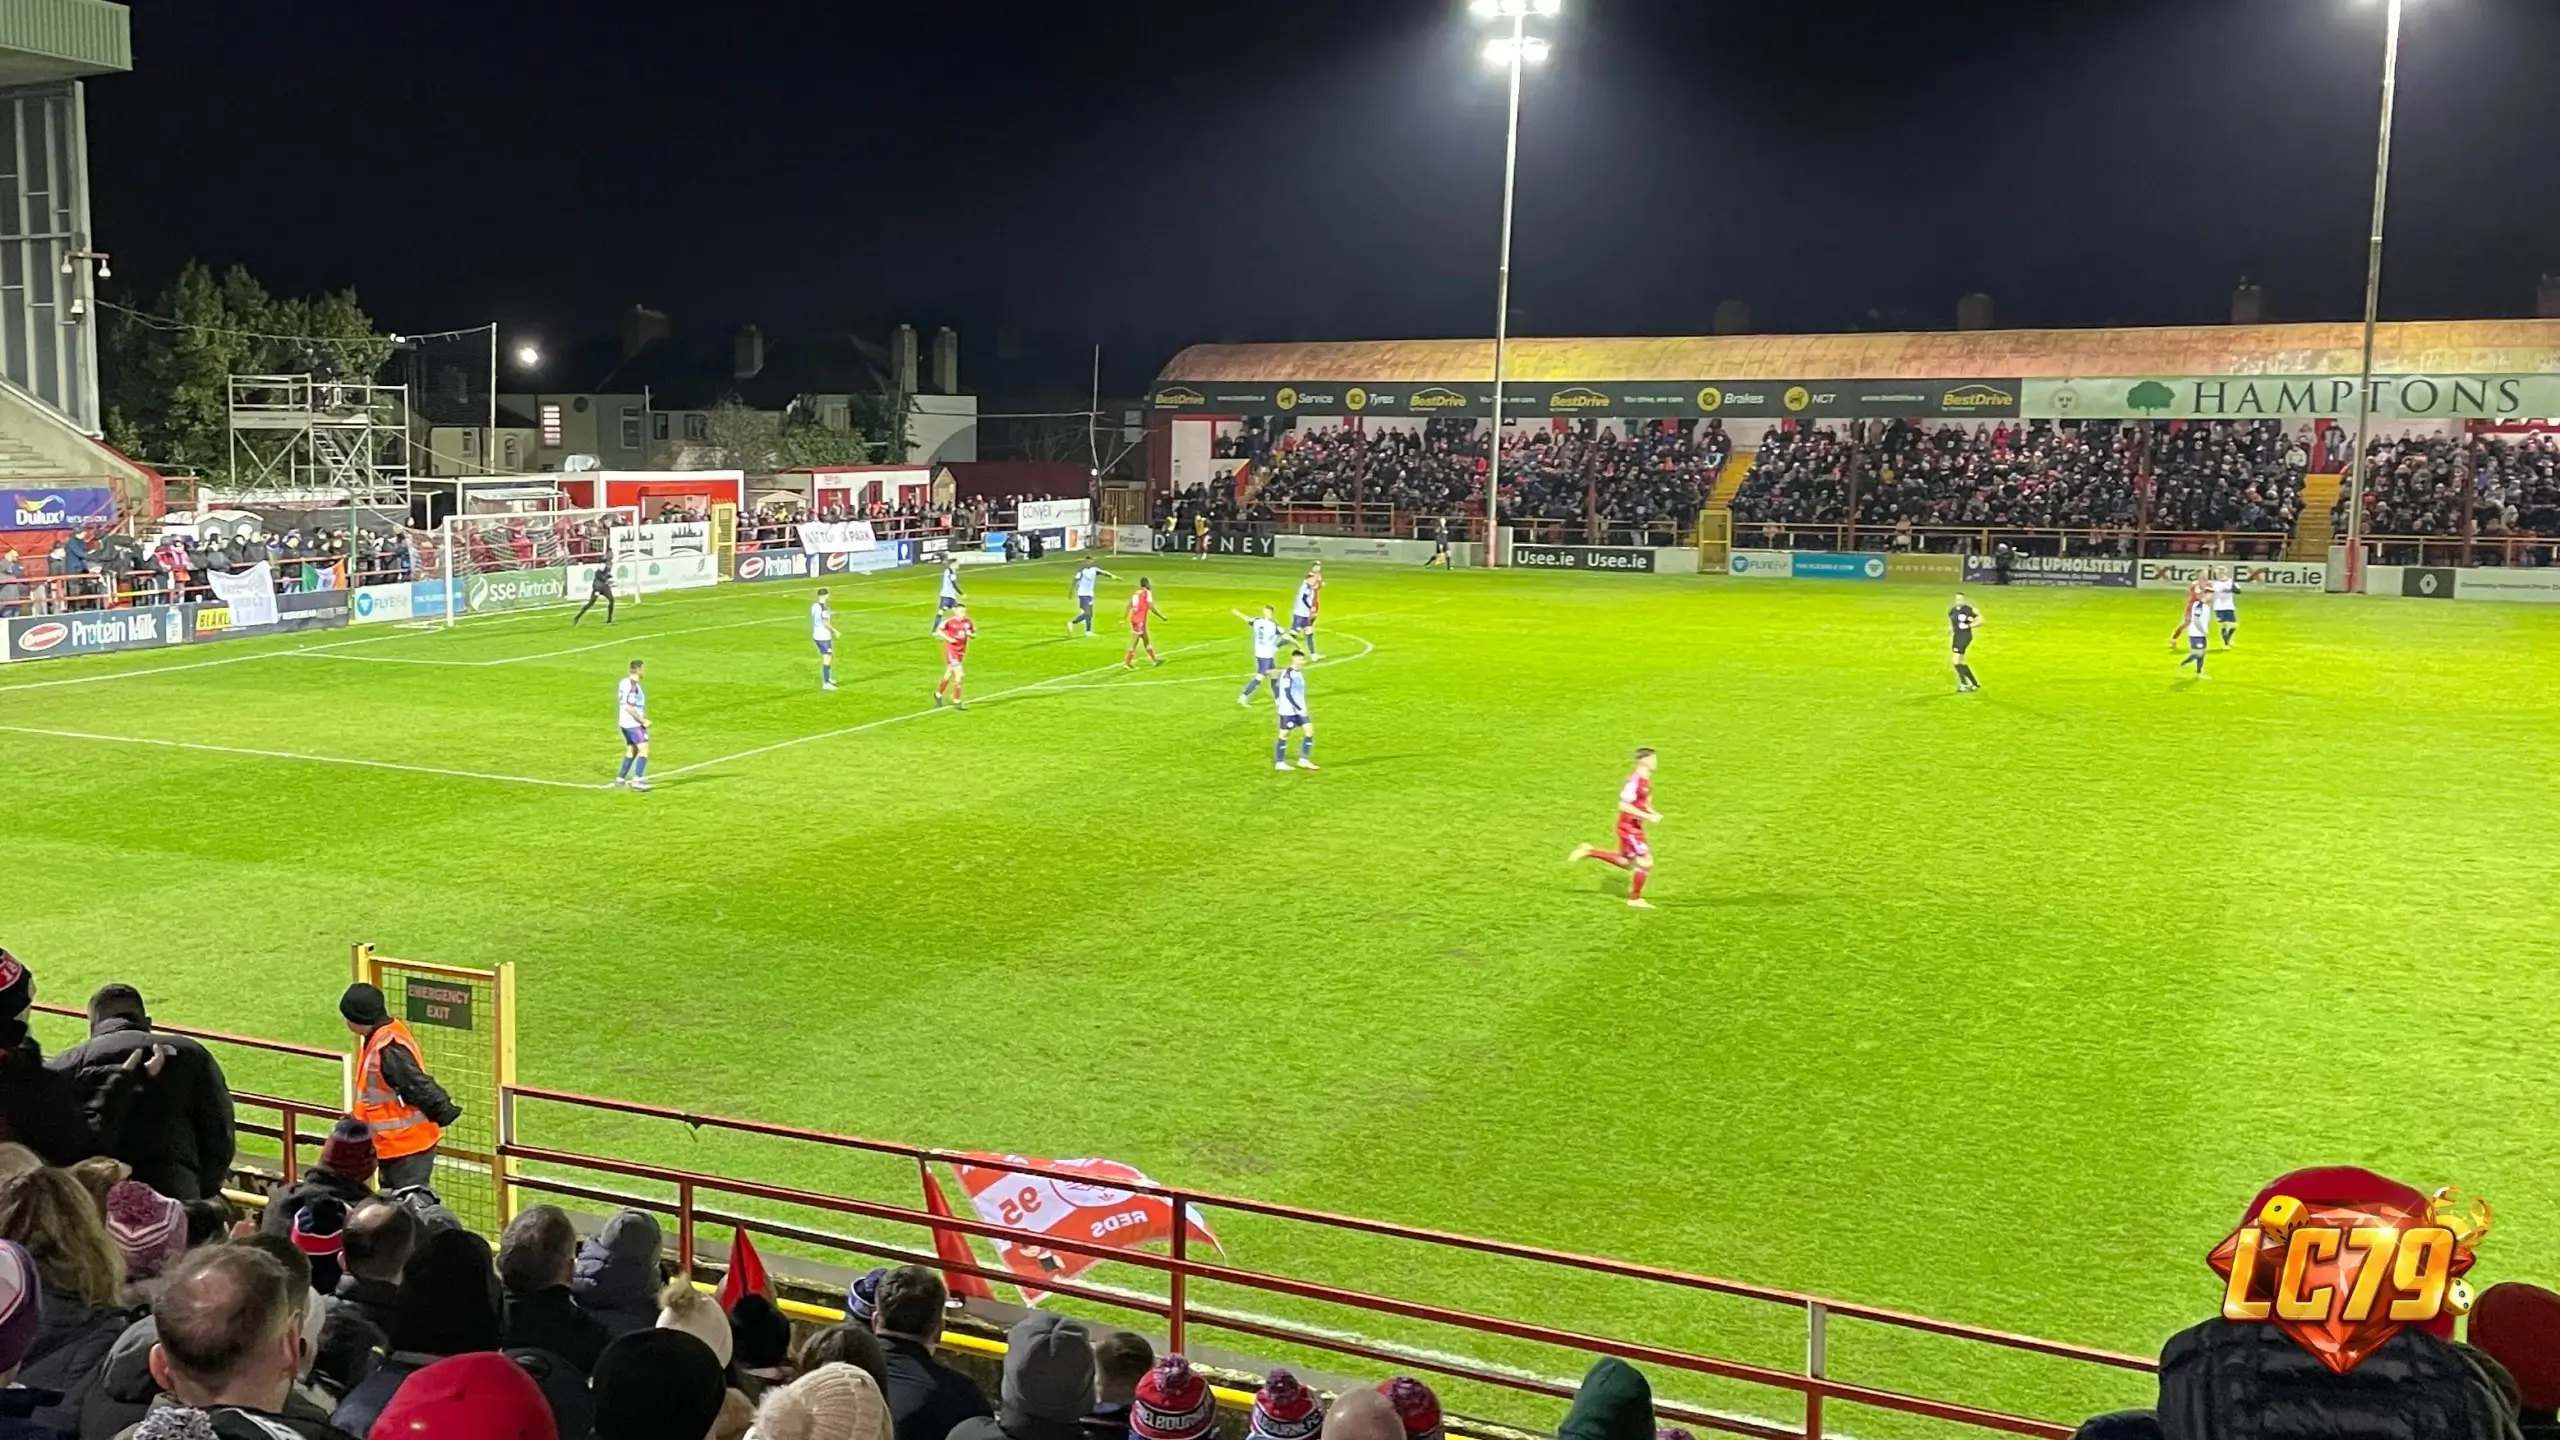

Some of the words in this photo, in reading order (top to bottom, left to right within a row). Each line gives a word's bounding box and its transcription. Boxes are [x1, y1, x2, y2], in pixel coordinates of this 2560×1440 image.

[1298, 393, 1334, 404] Service
[1369, 394, 1395, 405] Tyres
[1410, 395, 1467, 407] BestDrive
[1550, 395, 1610, 407] BestDrive
[1724, 393, 1764, 405] Brakes
[1812, 394, 1836, 404] NCT
[1943, 394, 2013, 406] BestDrive
[2191, 378, 2521, 414] HAMPTONS
[16, 509, 62, 525] Dulux
[1517, 551, 1575, 566] Usee.ie
[1587, 552, 1648, 569] Usee.ie
[2042, 557, 2133, 573] UPHOLSTERY
[2233, 565, 2322, 585] Extra.ie
[489, 583, 516, 602] sse
[518, 578, 565, 598] Airtricity
[71, 618, 126, 647] Protein
[127, 613, 158, 641] Milk
[408, 984, 470, 1005] EMERGENCY
[426, 1004, 451, 1019] EXIT
